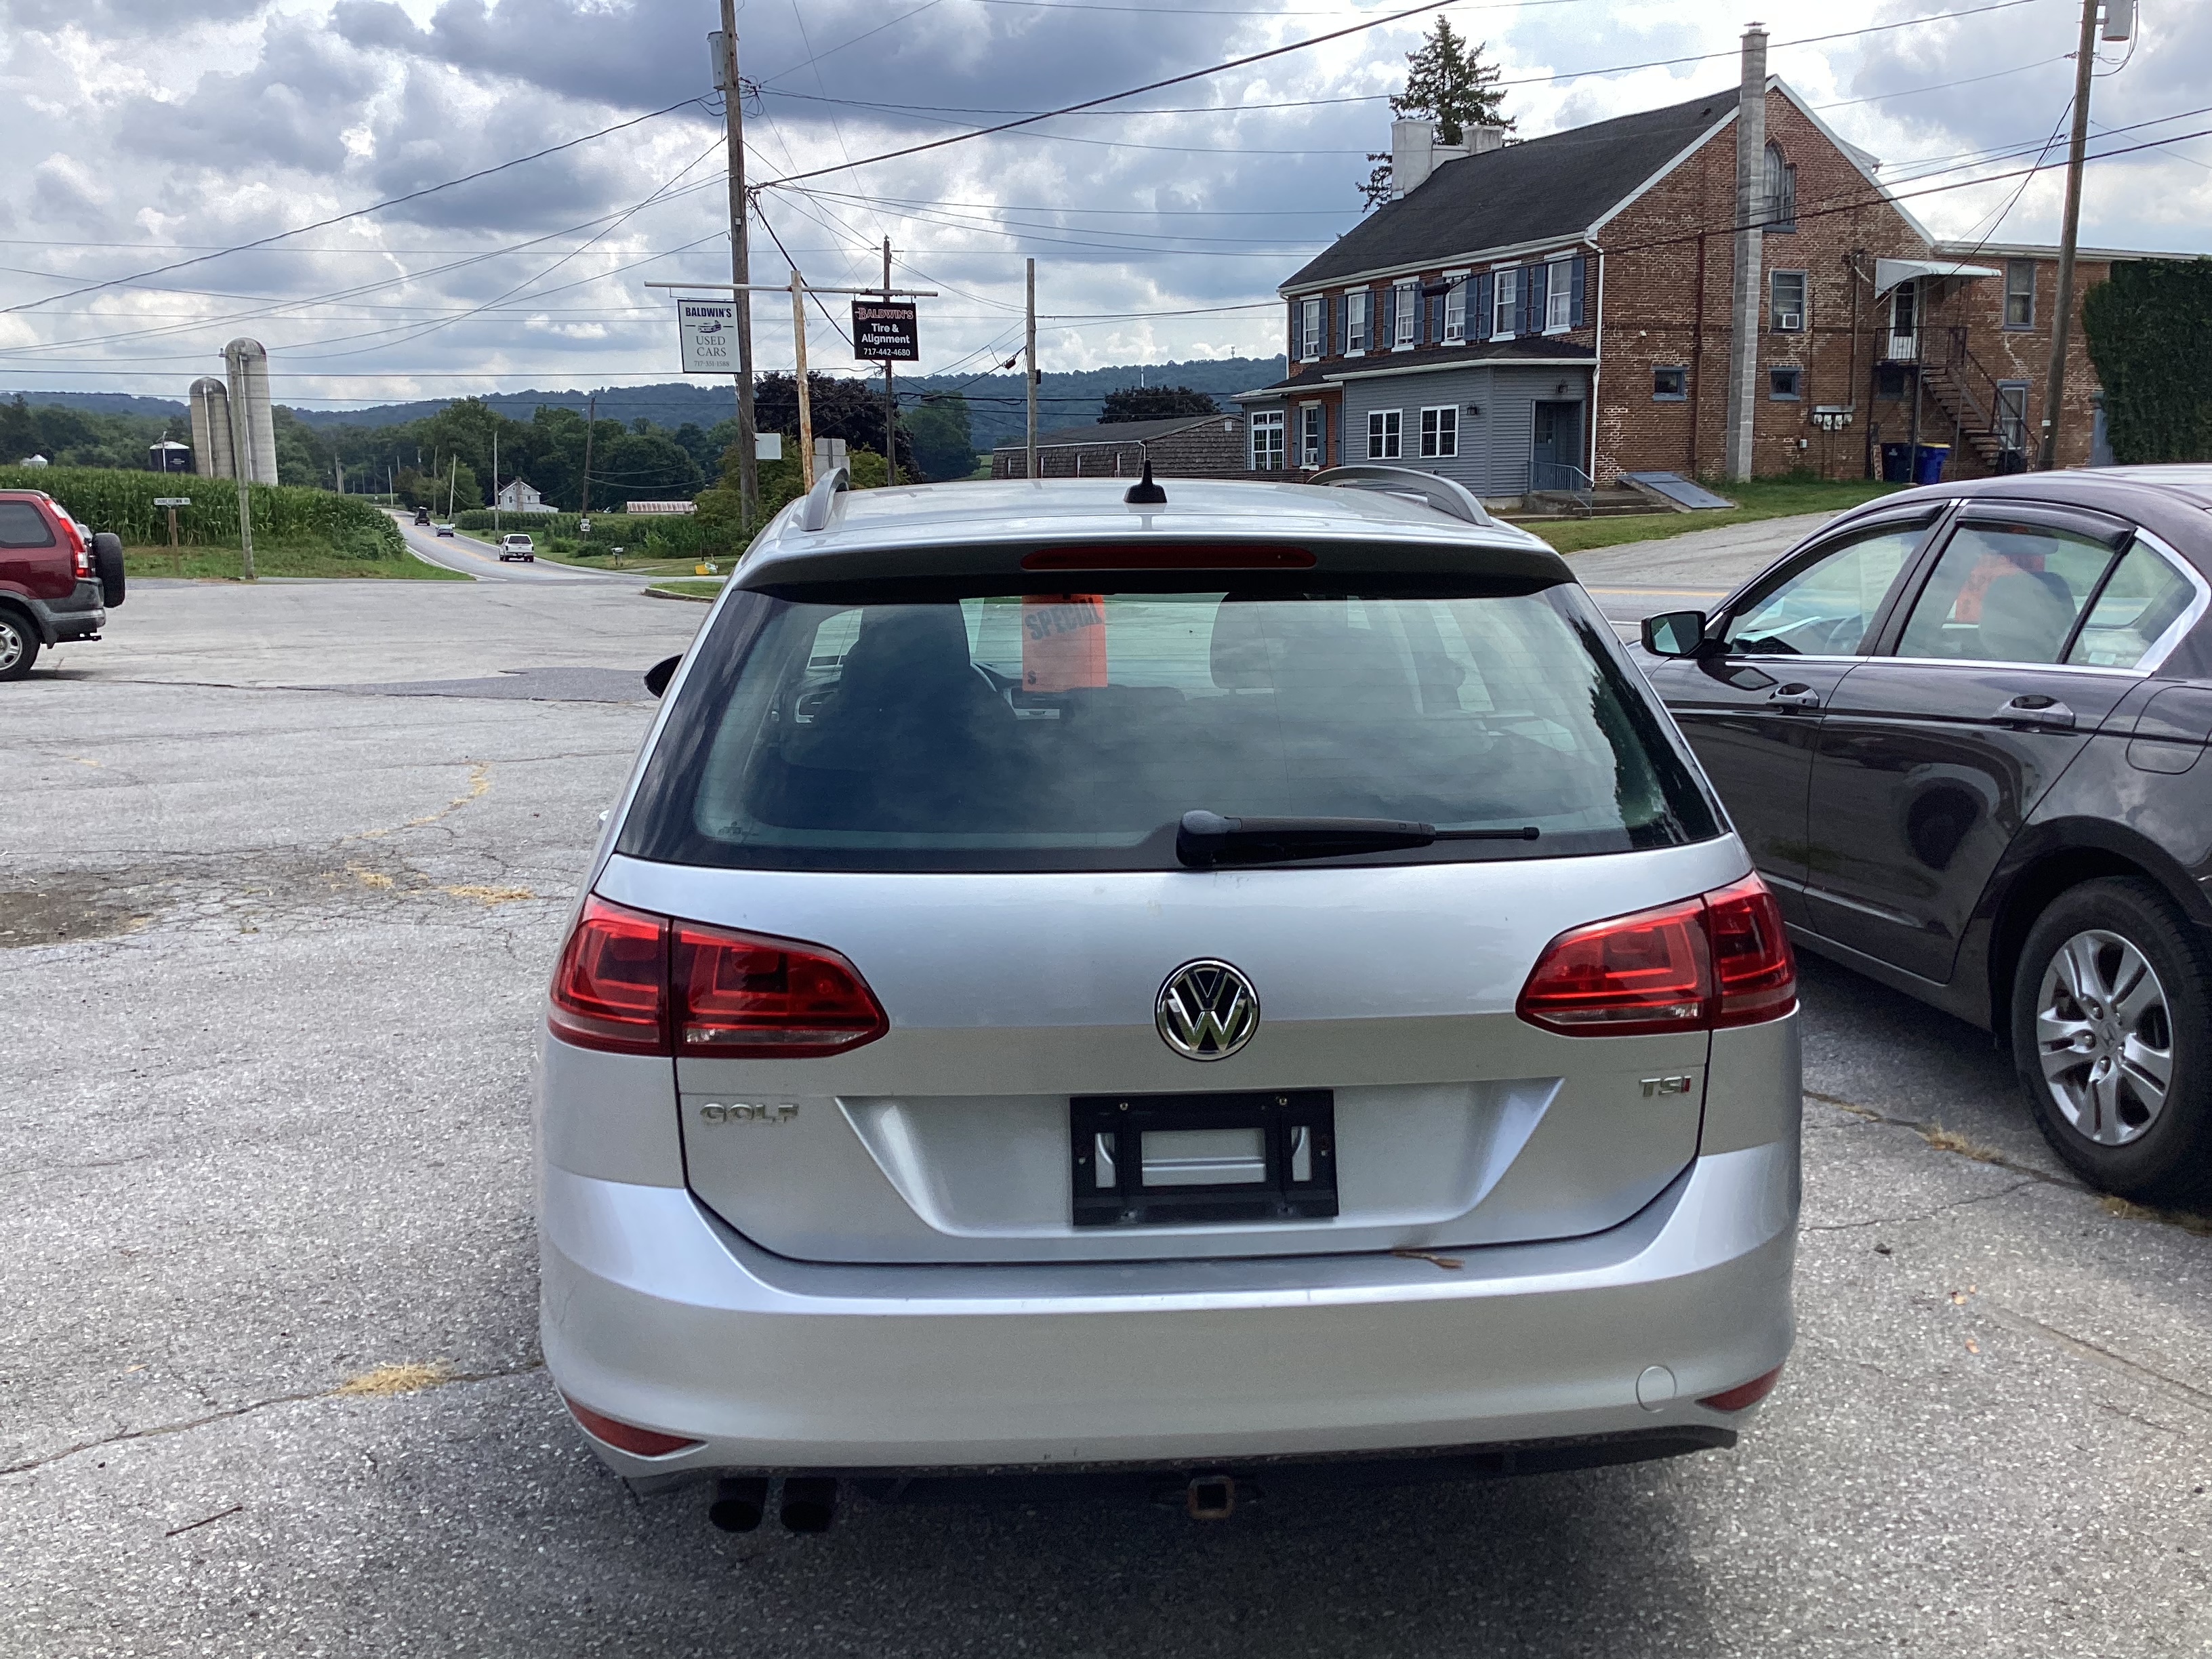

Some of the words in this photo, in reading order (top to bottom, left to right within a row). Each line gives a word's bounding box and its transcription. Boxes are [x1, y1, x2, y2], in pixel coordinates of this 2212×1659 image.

[685, 307, 732, 318] BALDWIN'S
[855, 307, 914, 320] BALDWIN'S
[871, 323, 890, 333] Tire
[891, 324, 899, 333] &
[695, 335, 726, 345] USED
[861, 333, 910, 345] Alignment
[697, 347, 726, 357] CARS
[863, 348, 911, 356] 717-442-4680
[1025, 597, 1103, 640] SPECIAL
[699, 1102, 800, 1124] GOLF
